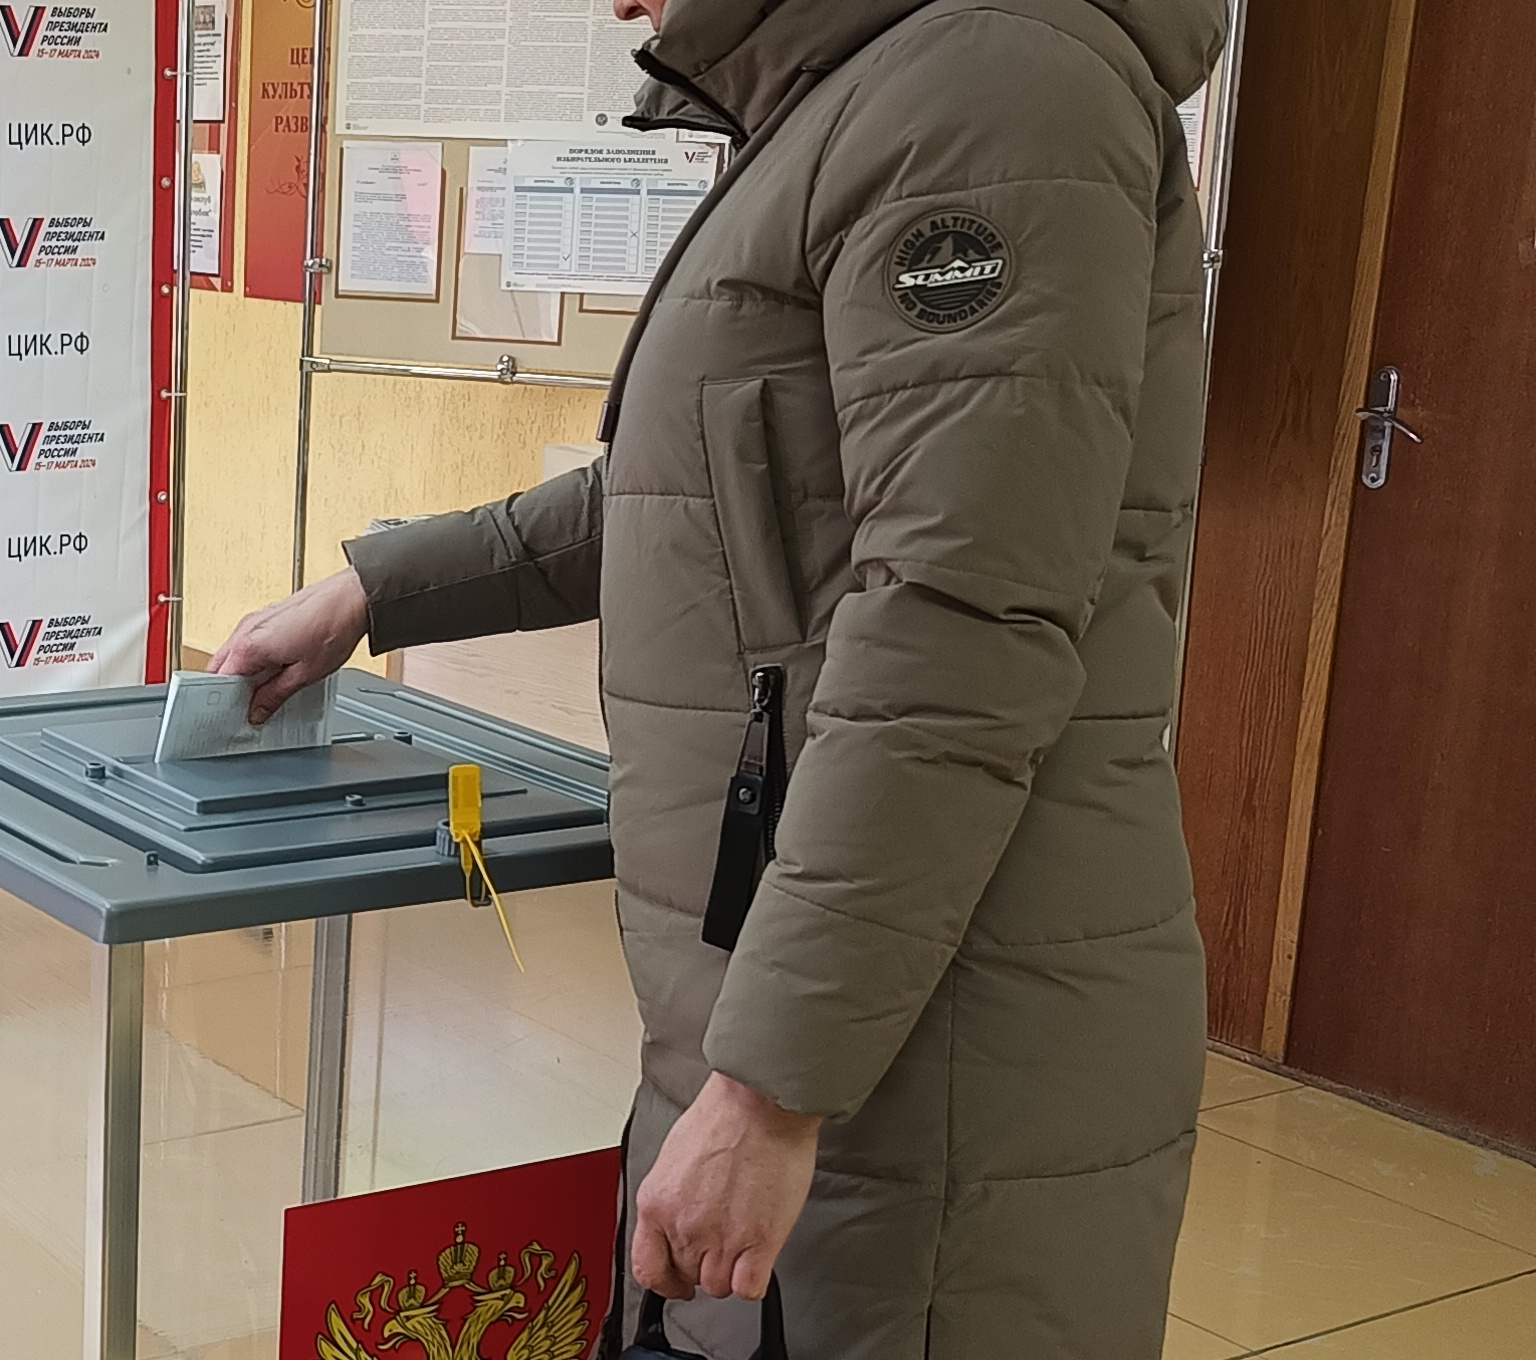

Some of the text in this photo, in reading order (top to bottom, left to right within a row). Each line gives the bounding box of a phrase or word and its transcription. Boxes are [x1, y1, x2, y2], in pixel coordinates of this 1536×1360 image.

[9, 123, 91, 150] ЦИК.РФ
[43, 231, 105, 241] ПРЕЗИДЕНТА
[48, 217, 92, 227] ВЫБОРЫ
[38, 245, 78, 255] РОССИИ
[894, 216, 1003, 267] HIGH ALTITUDE
[894, 259, 1003, 288] SUMMIT
[8, 332, 89, 361] ЦИК.РФ
[8, 532, 88, 562] ЦИК.РФ
